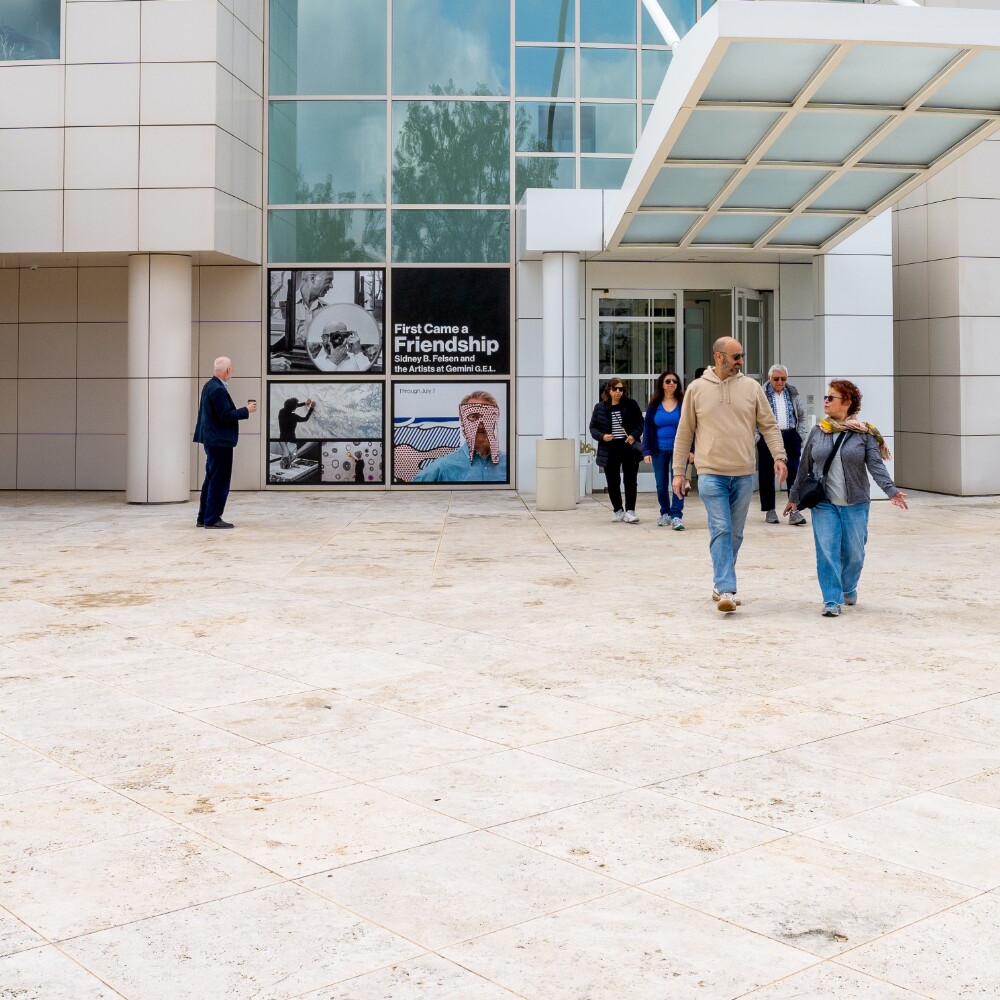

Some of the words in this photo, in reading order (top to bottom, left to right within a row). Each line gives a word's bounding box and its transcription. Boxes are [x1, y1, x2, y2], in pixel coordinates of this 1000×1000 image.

[394, 323, 422, 334] First
[423, 323, 459, 334] Came
[461, 325, 469, 334] a
[394, 336, 499, 355] Friendship
[394, 355, 422, 363] Sidney
